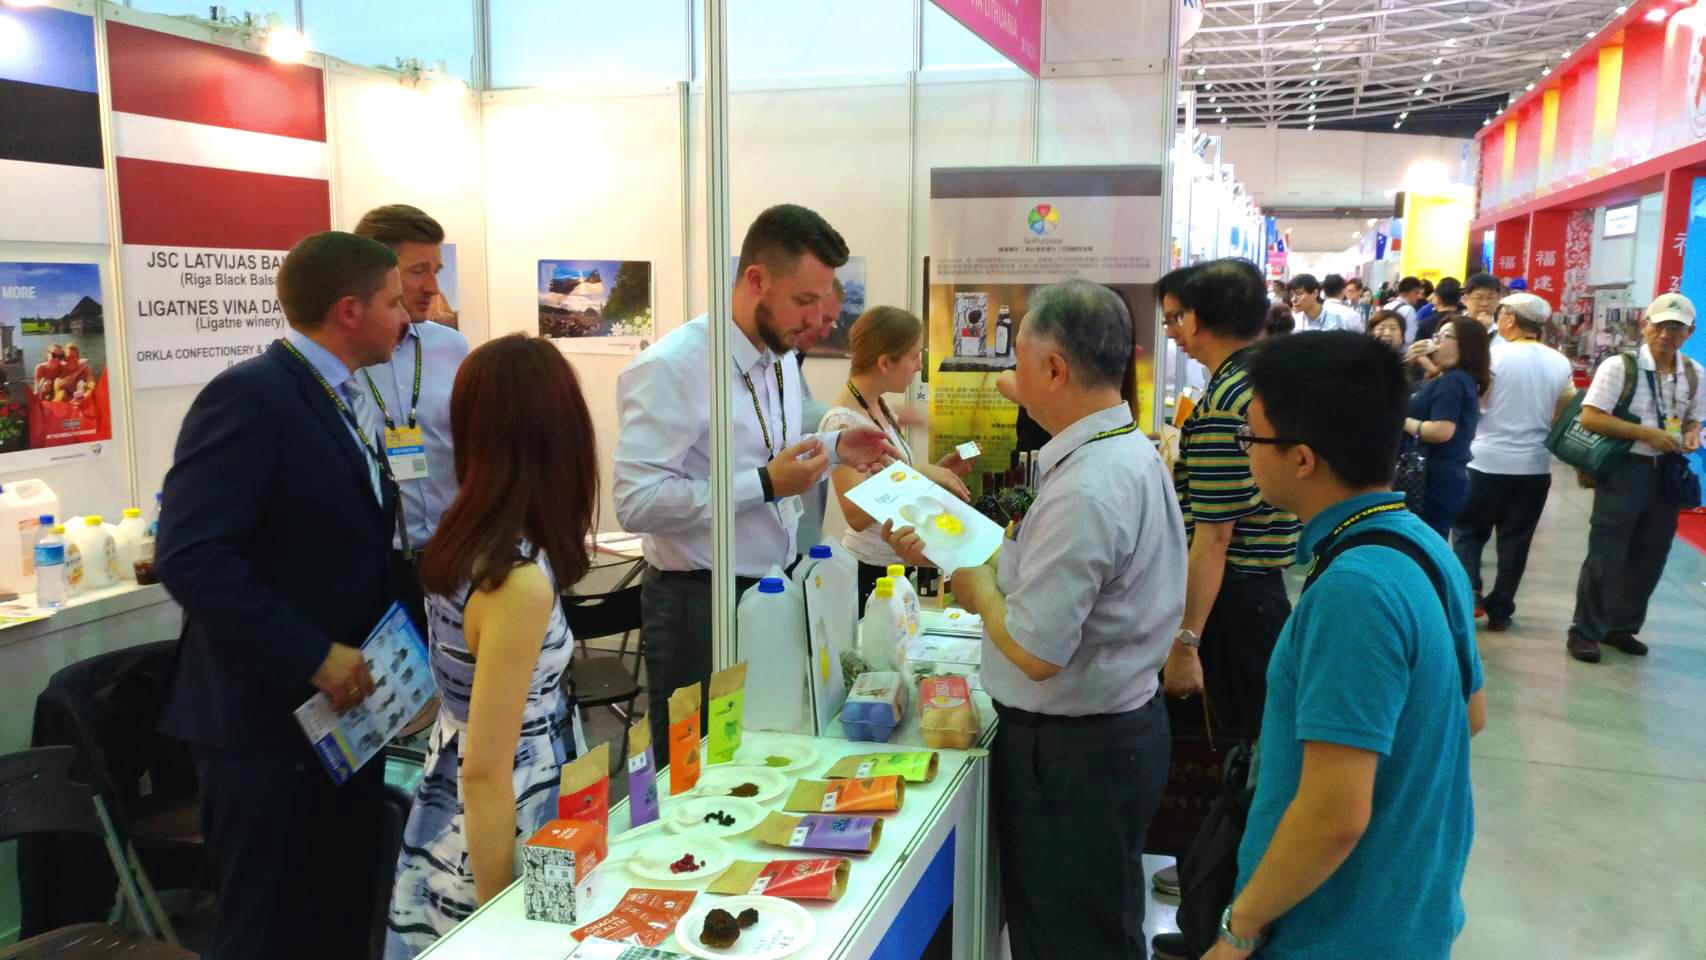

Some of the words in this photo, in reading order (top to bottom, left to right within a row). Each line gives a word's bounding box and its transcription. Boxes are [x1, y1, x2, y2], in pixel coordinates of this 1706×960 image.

[147, 252, 179, 268] JSC
[184, 253, 257, 270] LATVIJAS
[261, 255, 286, 270] BA
[180, 273, 212, 288] (Riga
[215, 273, 247, 286] Black
[2, 286, 37, 299] MORE
[138, 300, 219, 317] LIGATNES
[223, 300, 258, 315] VINA
[262, 300, 283, 314] DA
[195, 316, 242, 332] (Ligatne
[246, 316, 285, 329] winery)
[137, 351, 173, 362] ORKLA
[175, 345, 254, 359] CONFECTIONERY
[256, 344, 263, 354] &
